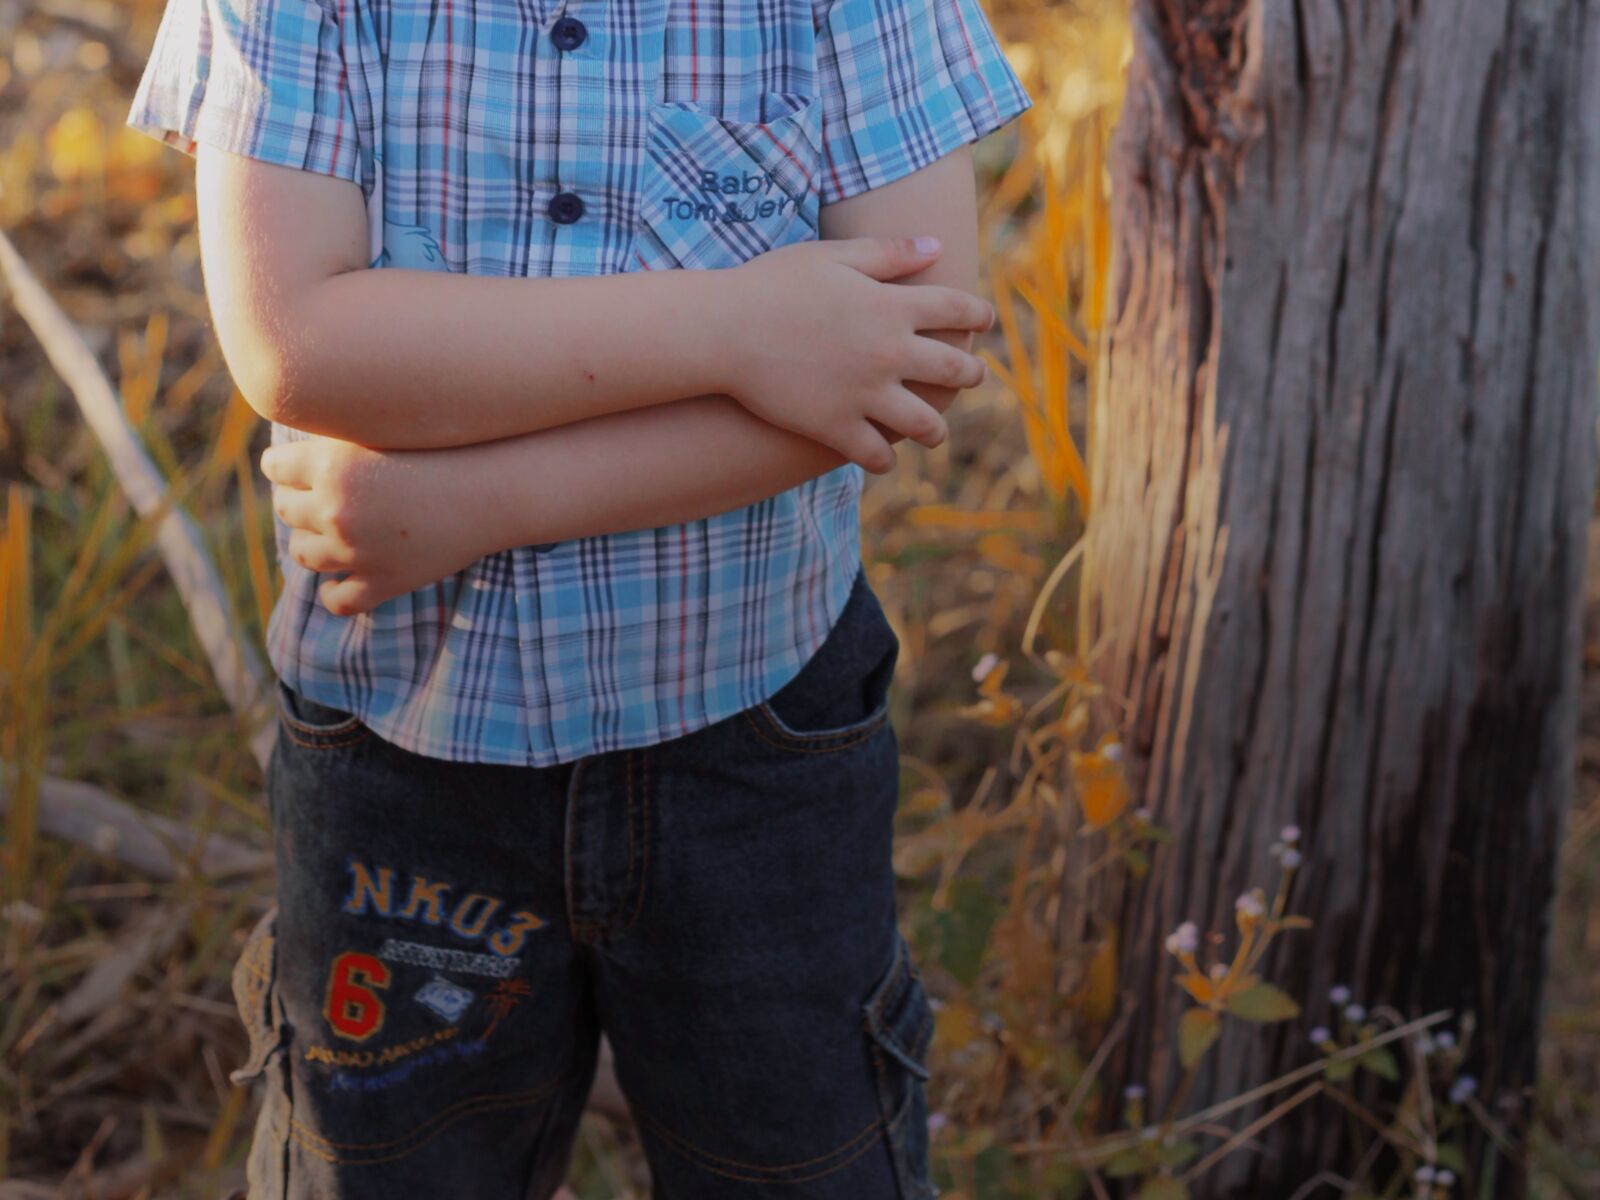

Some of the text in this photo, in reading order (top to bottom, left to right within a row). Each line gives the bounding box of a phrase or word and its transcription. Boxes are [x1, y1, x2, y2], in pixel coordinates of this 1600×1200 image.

[698, 170, 776, 196] Baby
[662, 196, 717, 222] Tom
[322, 950, 391, 1043] 6
